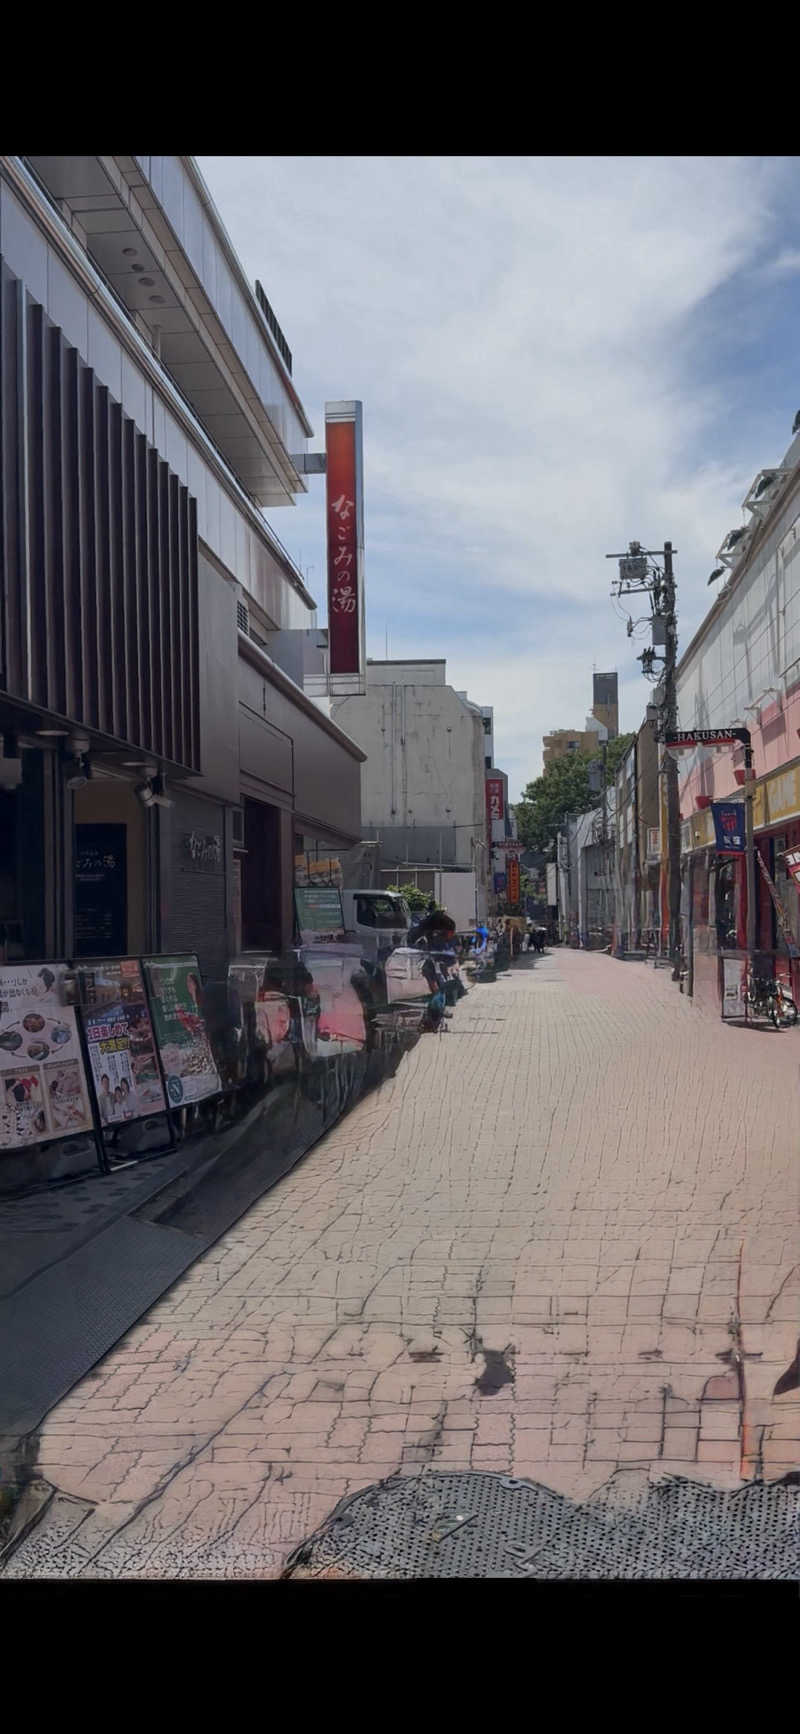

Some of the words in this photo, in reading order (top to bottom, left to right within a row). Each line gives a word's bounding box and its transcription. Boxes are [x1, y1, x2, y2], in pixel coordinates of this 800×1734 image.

[331, 494, 356, 613] なごみの湯
